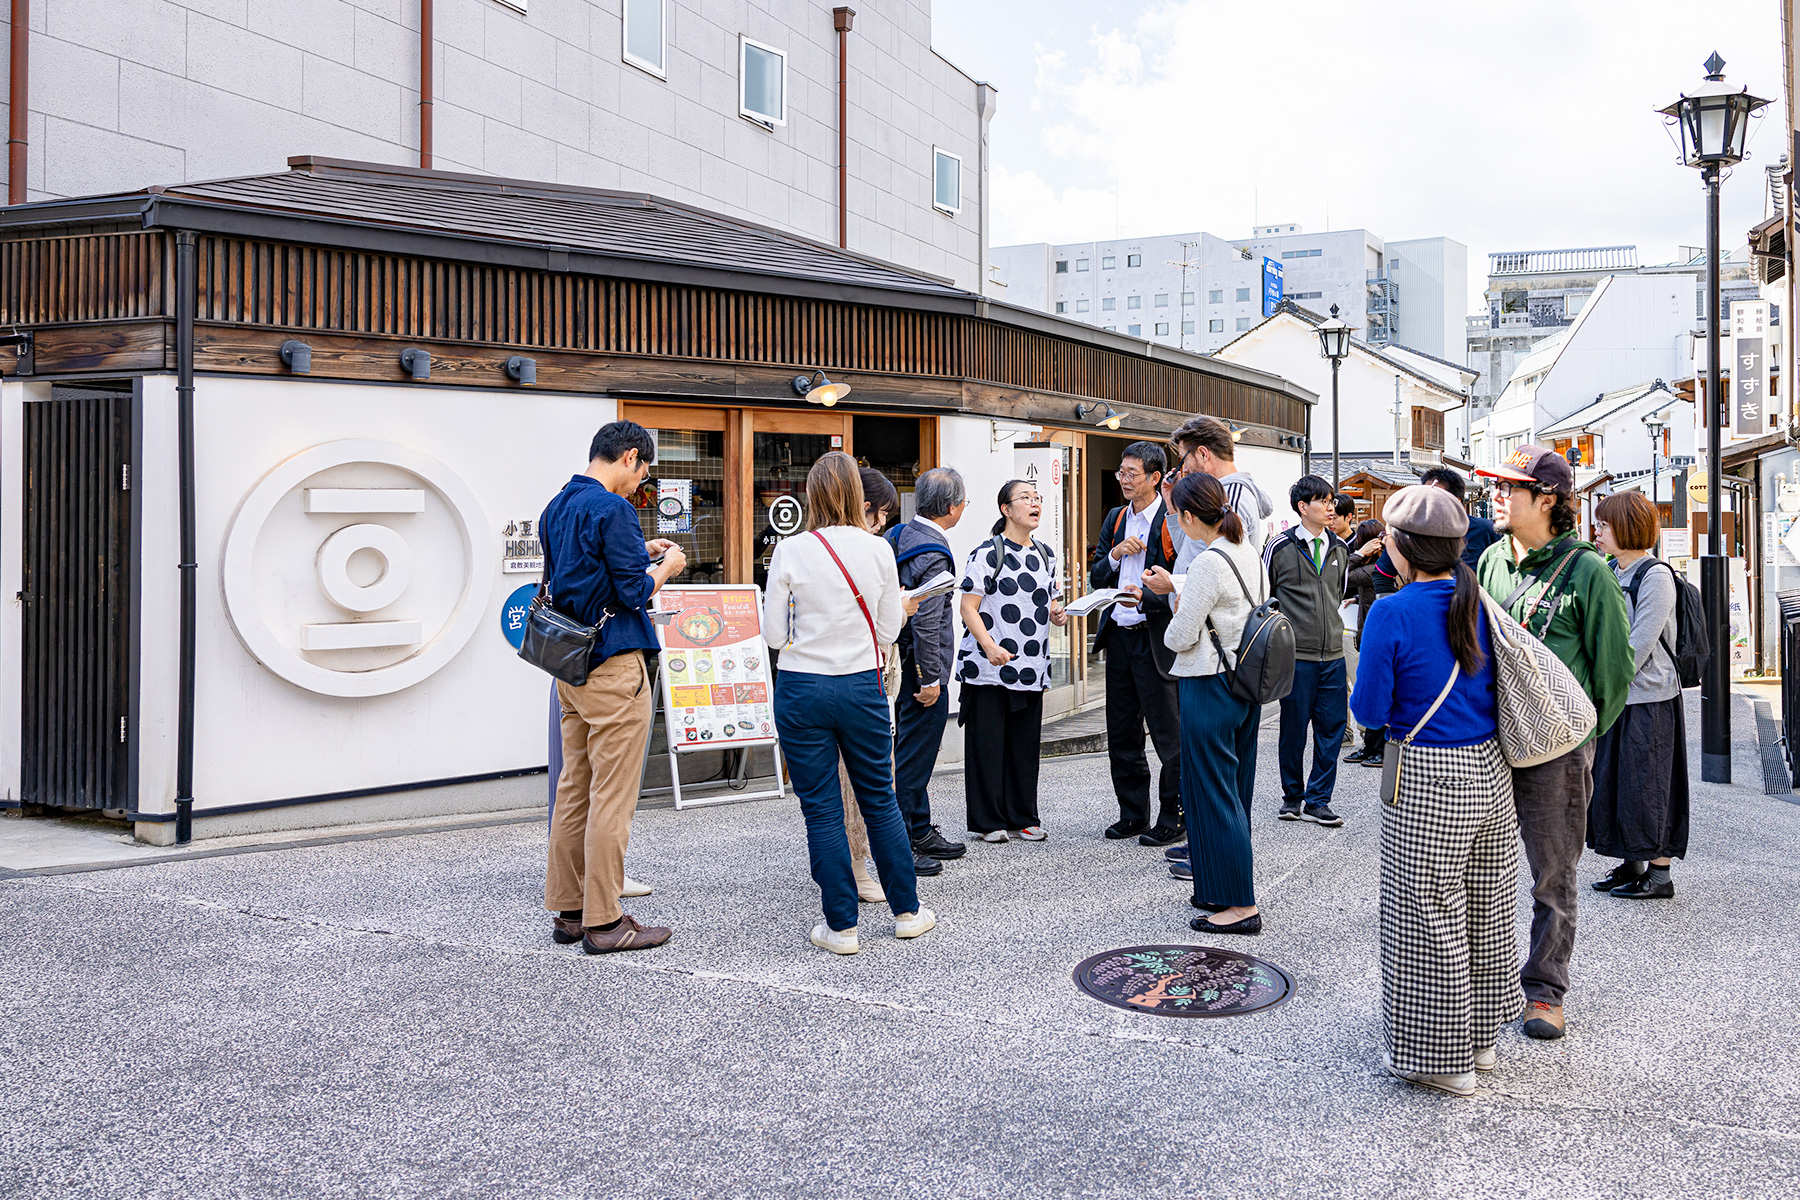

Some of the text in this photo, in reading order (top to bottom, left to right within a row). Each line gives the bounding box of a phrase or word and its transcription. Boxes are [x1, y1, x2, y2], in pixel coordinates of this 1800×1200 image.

[1740, 352, 1760, 420] すずき
[510, 561, 544, 569] 倉敷美観地
[508, 605, 526, 630] 営
